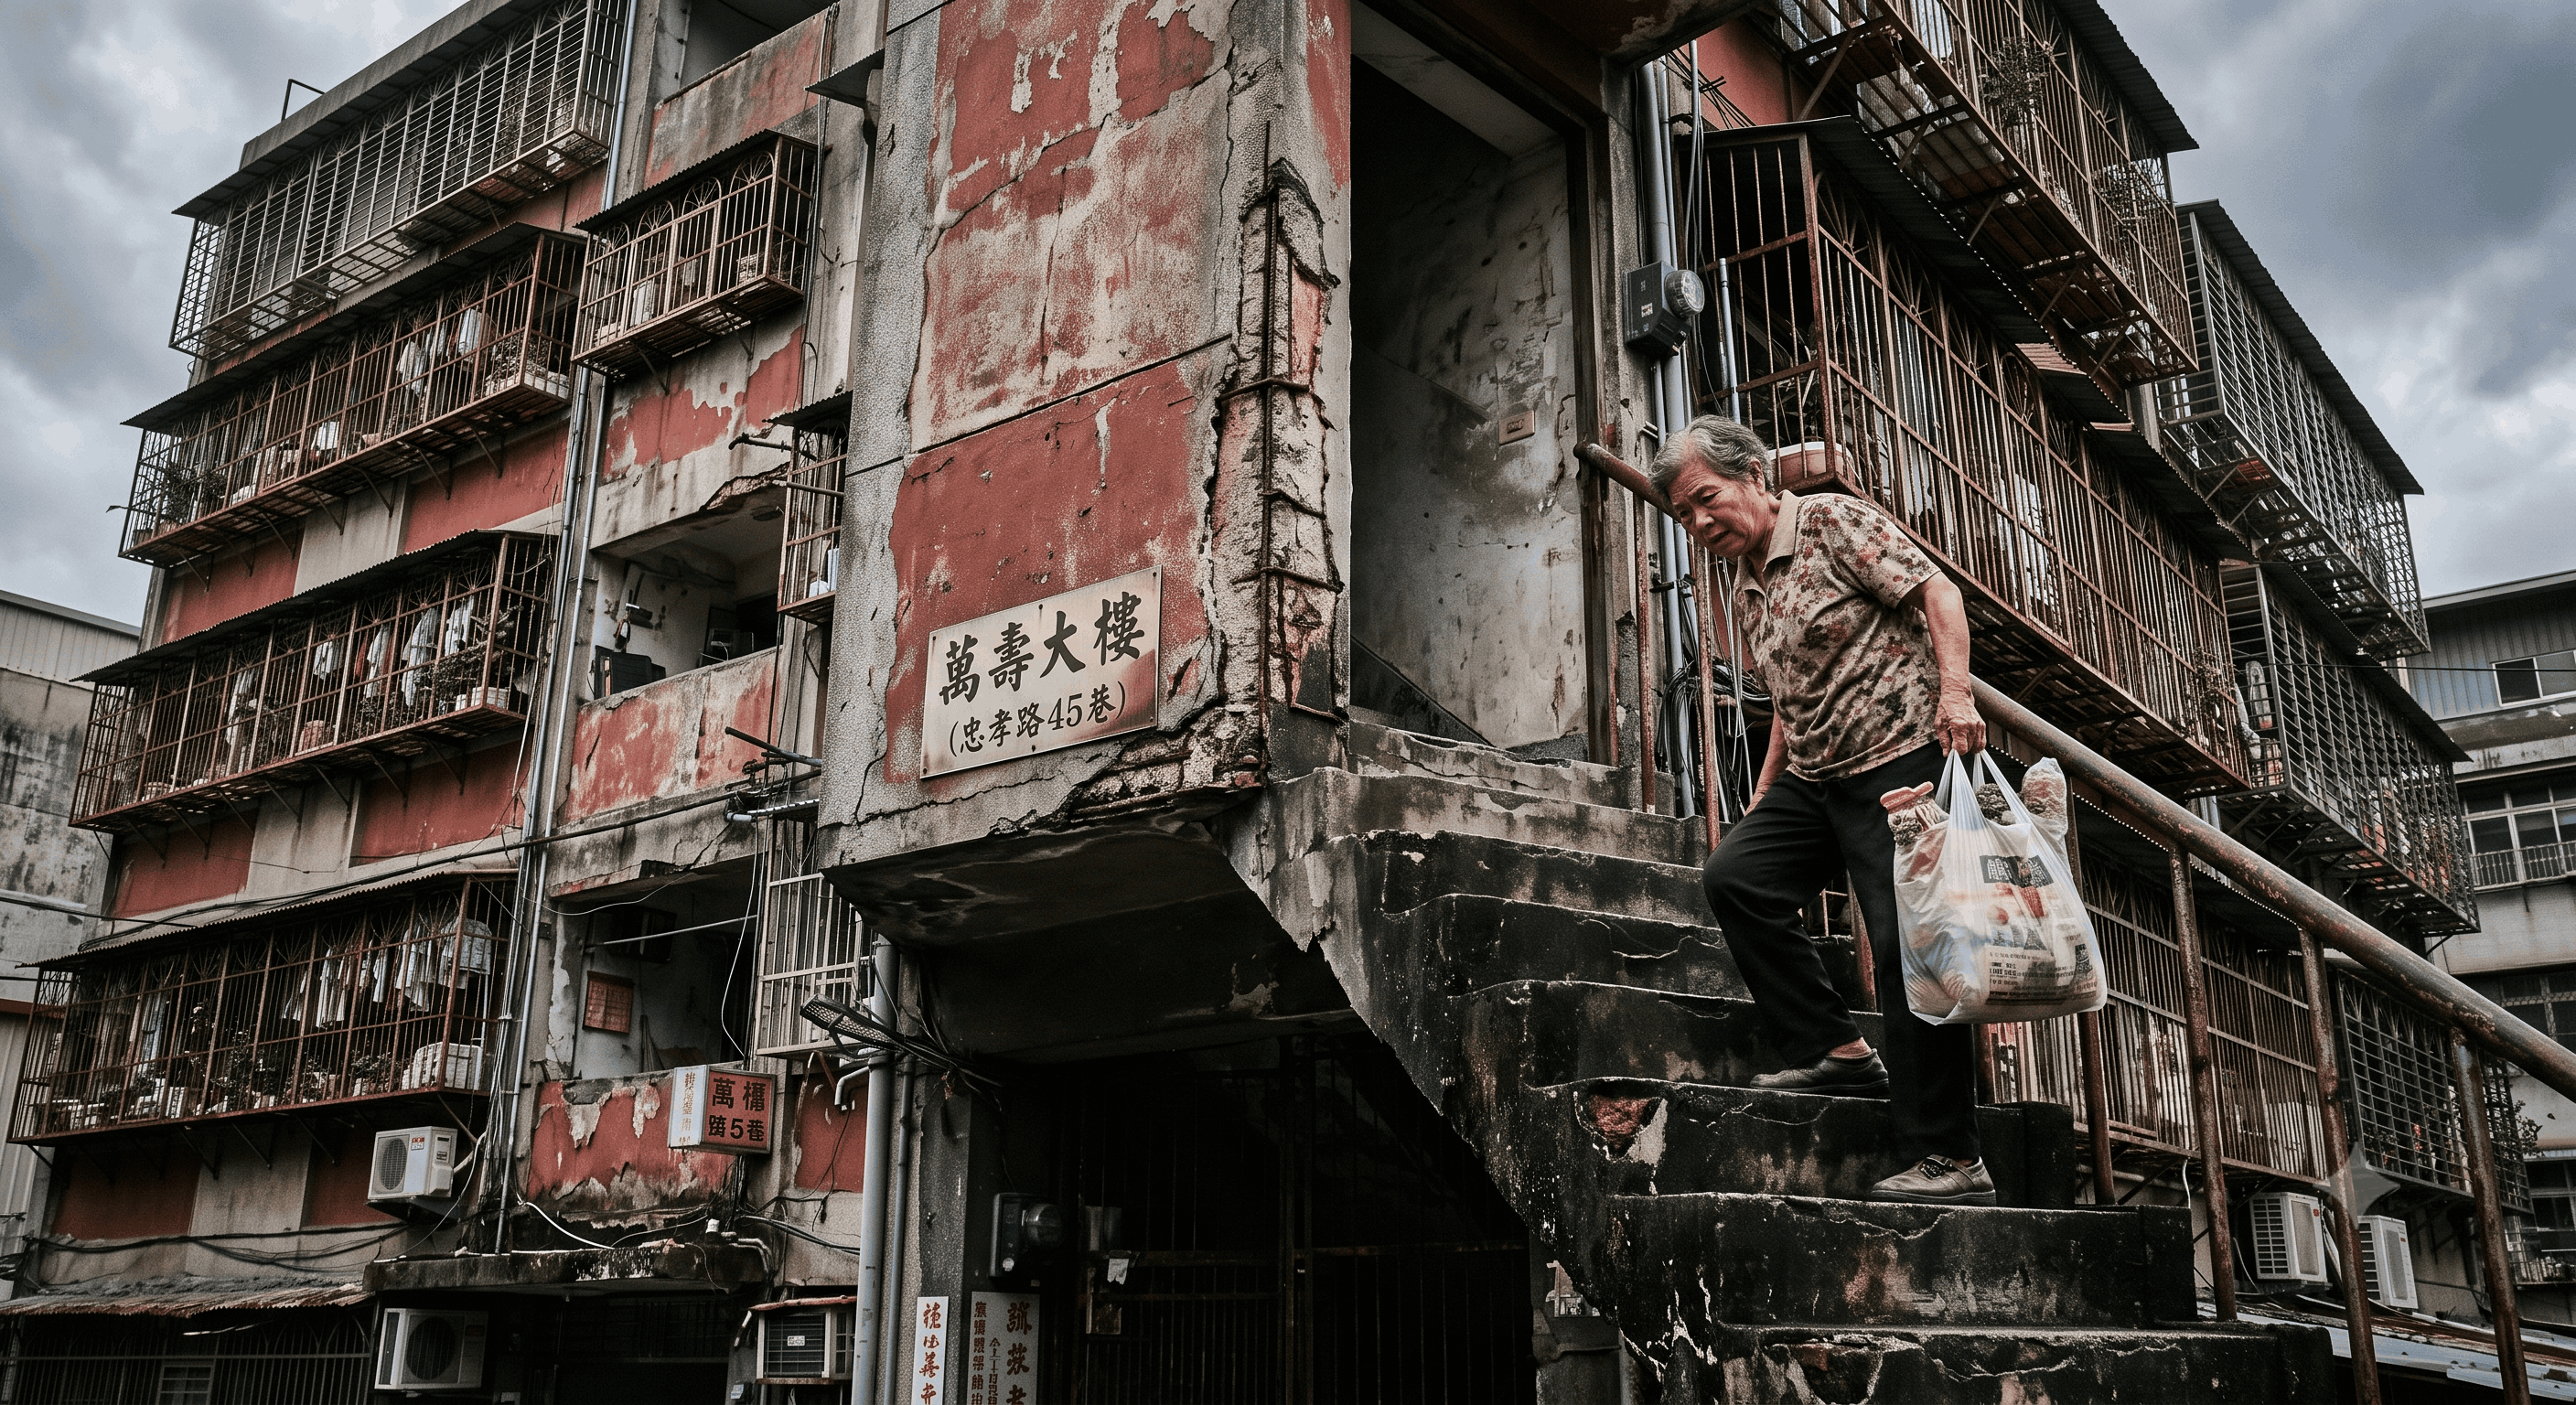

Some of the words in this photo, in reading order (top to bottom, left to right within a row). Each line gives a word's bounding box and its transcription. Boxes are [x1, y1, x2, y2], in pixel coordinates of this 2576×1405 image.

[939, 591, 1145, 706] 萬壽大樓
[949, 681, 1126, 757] (忠孝路45巷)
